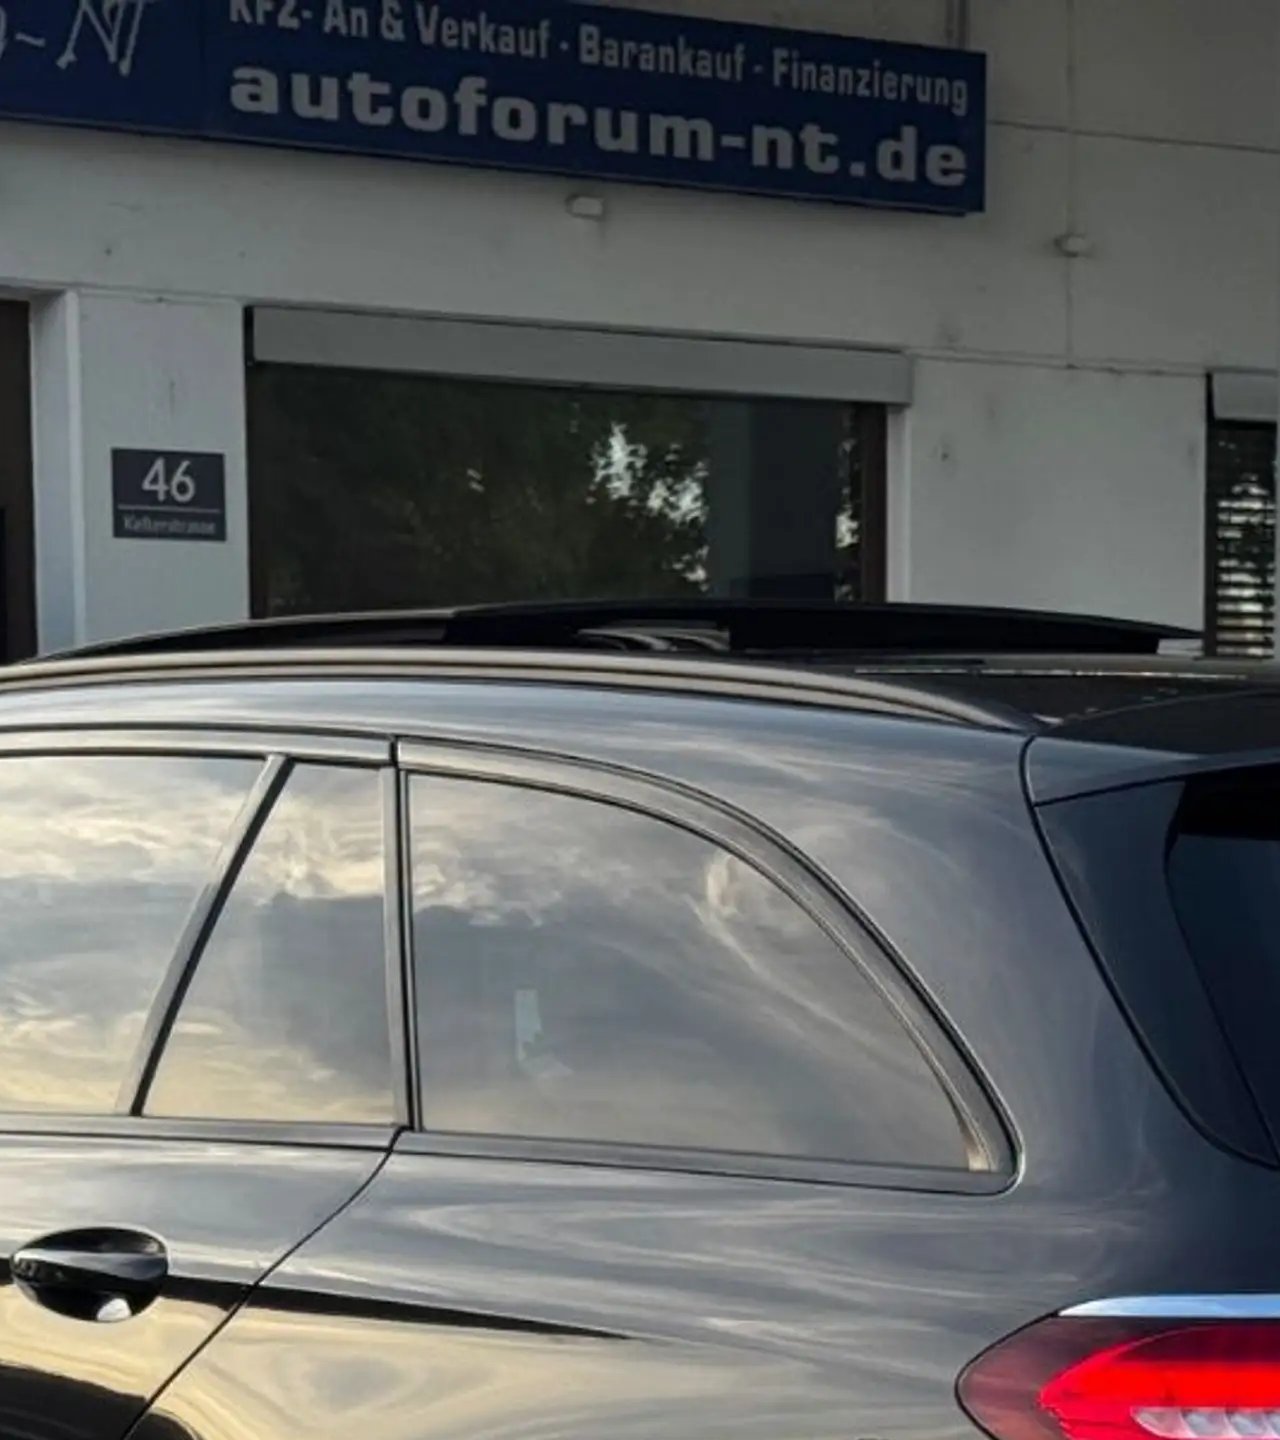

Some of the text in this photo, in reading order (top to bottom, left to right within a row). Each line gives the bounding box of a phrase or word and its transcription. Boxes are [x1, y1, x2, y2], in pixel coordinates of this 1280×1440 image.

[323, 0, 368, 37] An
[380, 0, 406, 41] &
[416, 3, 551, 59] Verkauf
[579, 24, 747, 83] Barankauf
[772, 47, 968, 114] Finanzierung
[229, 65, 967, 187] autoforum-nt.de
[141, 456, 196, 503] 46
